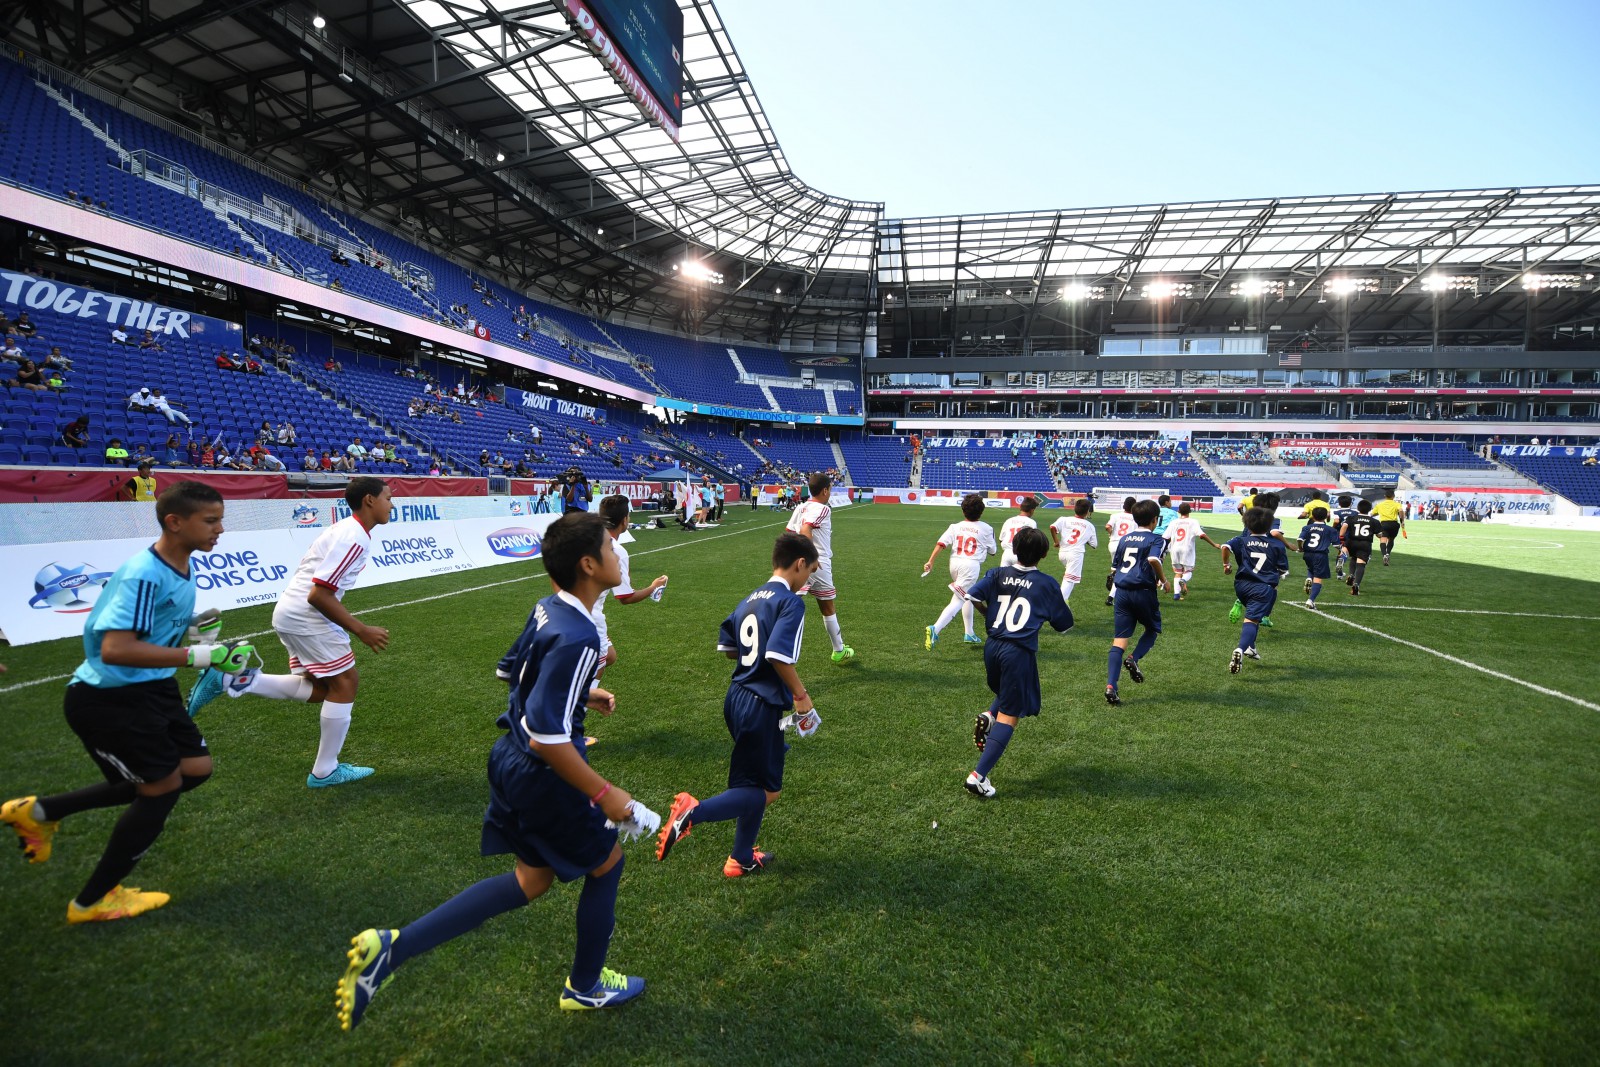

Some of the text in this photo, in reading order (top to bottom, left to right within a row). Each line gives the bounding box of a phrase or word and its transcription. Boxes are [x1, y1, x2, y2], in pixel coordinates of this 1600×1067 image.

[641, 48, 663, 84] PORTUGAL
[0, 272, 191, 339] TOGETHER
[522, 391, 596, 420] SHOUT TOGETHER
[747, 412, 782, 421] NATIONS
[784, 414, 801, 422] CUP
[930, 438, 968, 447] WE LOVE
[992, 439, 1035, 448] WE FIGHT
[1058, 440, 1112, 449] WITH PASSION
[1132, 440, 1150, 449] FOR
[1326, 448, 1372, 456] TOGETHER
[1501, 445, 1551, 456] WE LOVE
[1582, 447, 1600, 456] WE
[620, 485, 651, 499] WARD
[402, 504, 440, 522] FINAL
[1467, 501, 1478, 510] IN
[1508, 501, 1550, 511] DREAMS
[1068, 528, 1080, 544] 3
[1118, 523, 1129, 536] 8
[1177, 528, 1186, 542] 9
[1354, 524, 1370, 536] 16
[493, 532, 542, 550] DANNON
[956, 536, 977, 556] 10
[1307, 533, 1320, 548] 3
[372, 548, 454, 568] NATIONS CUP
[1120, 547, 1139, 574] 5
[1250, 552, 1267, 574] 7
[246, 564, 288, 583] CUP
[1003, 577, 1032, 590] JAPAN
[236, 592, 278, 604] #DNC2017
[747, 590, 775, 603] JAPAN
[992, 595, 1031, 633] 10
[740, 614, 759, 666] 9
